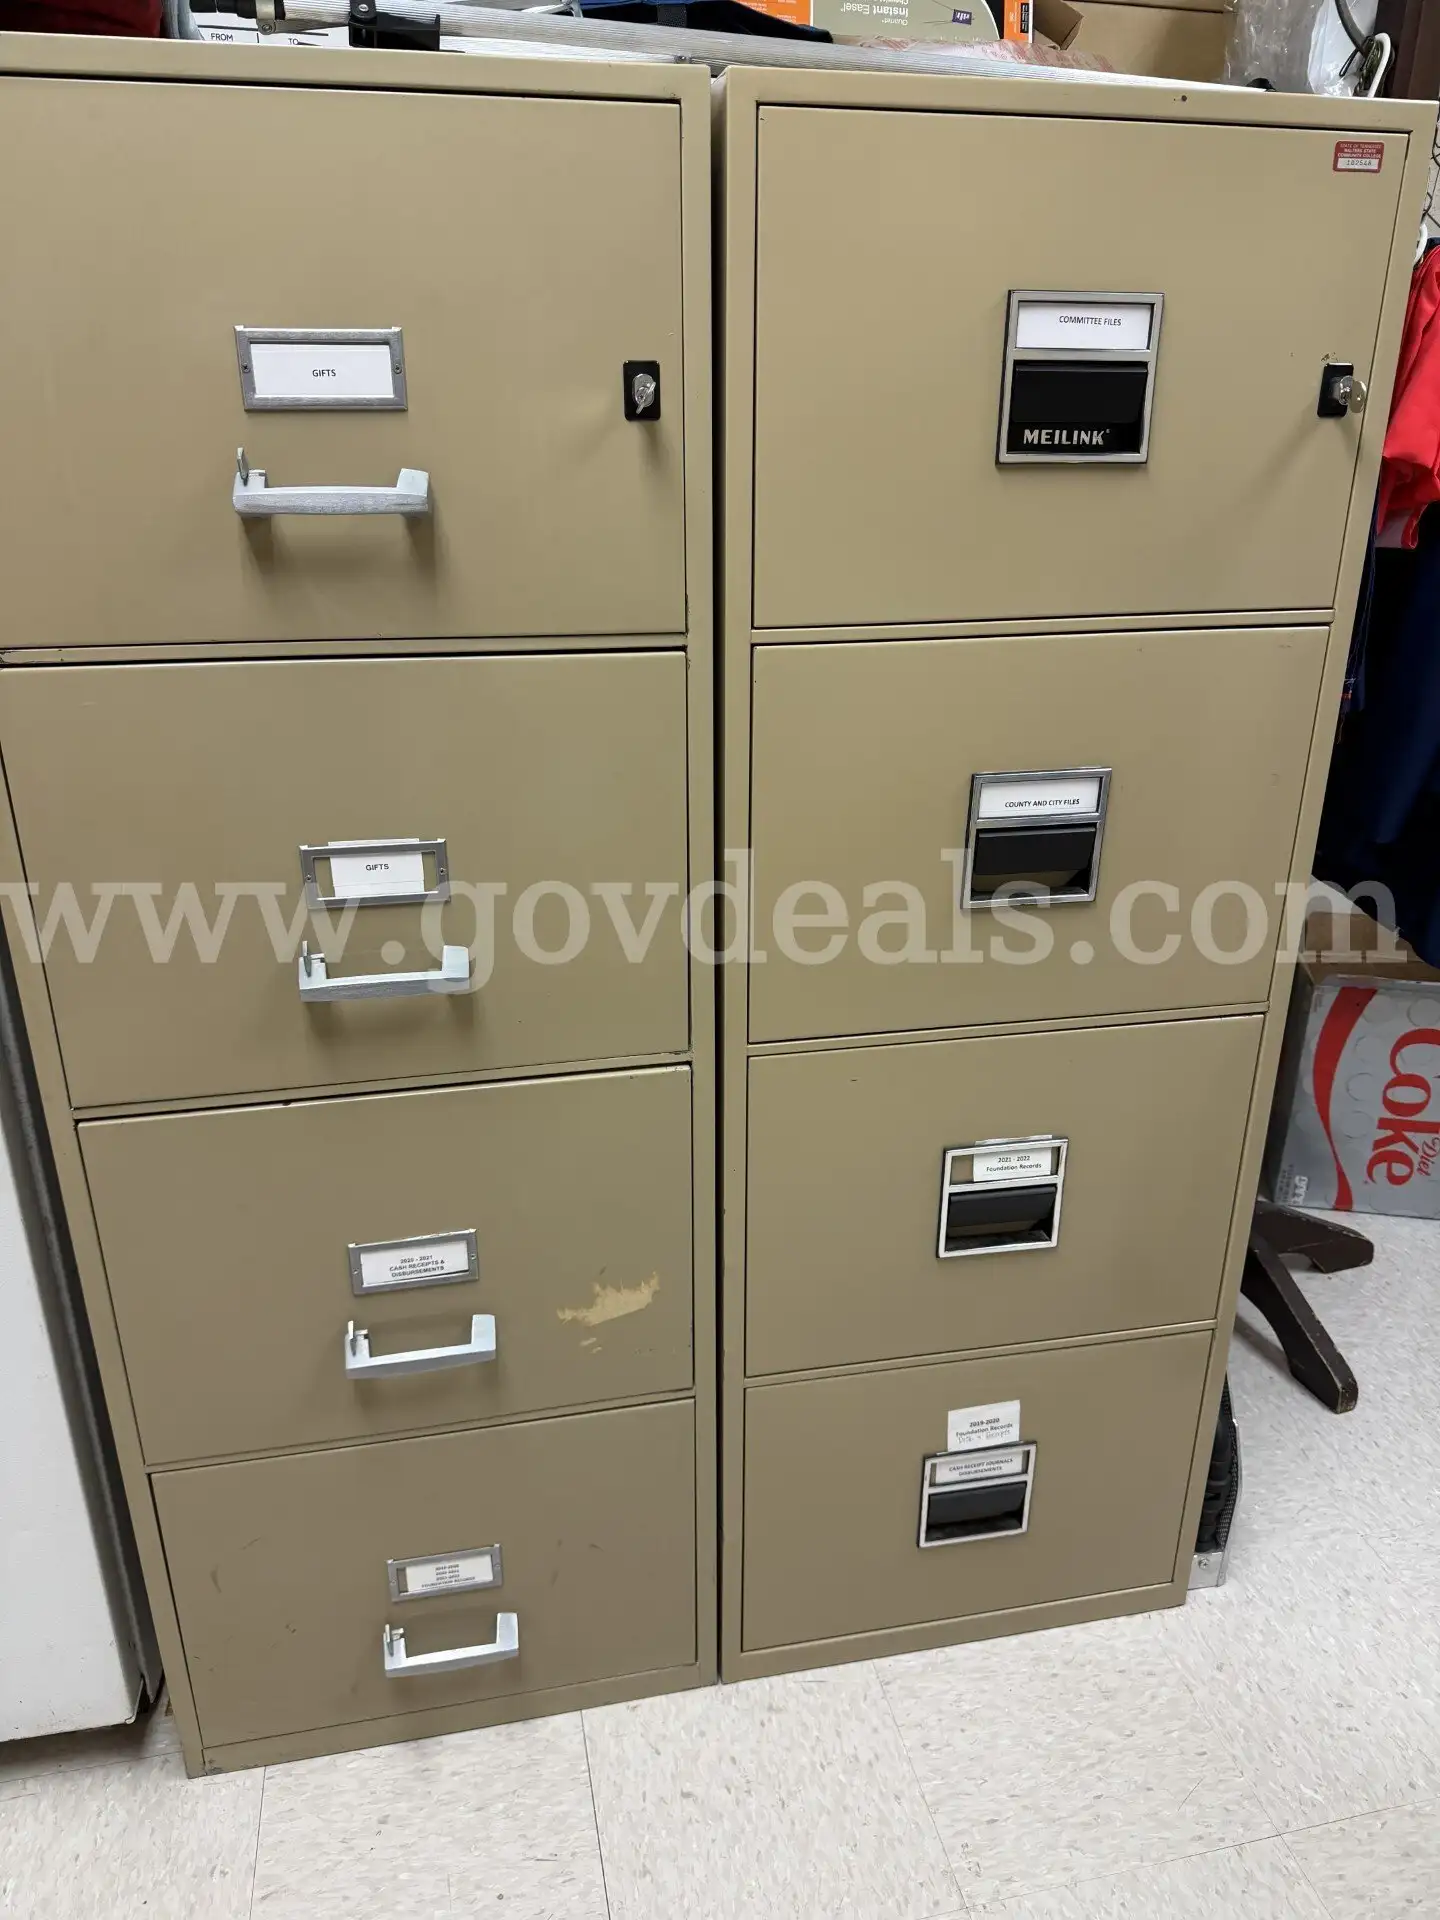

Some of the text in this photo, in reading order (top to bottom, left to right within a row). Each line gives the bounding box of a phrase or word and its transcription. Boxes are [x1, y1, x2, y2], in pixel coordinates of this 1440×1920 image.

[844, 3, 909, 17] Instant Easel
[210, 33, 234, 41] FROM
[1059, 315, 1122, 327] COMMITTEE FILES
[312, 369, 337, 377] GIFTS
[1023, 429, 1105, 445] MEILINK
[1005, 800, 1032, 808] COUNTY
[1032, 799, 1047, 807] AND
[1063, 798, 1080, 806] FILES
[365, 863, 390, 871] GIFTS
[1366, 1028, 1440, 1188] Coke
[1416, 1136, 1440, 1178] Diet
[986, 1163, 1018, 1172] Foundation
[408, 1260, 438, 1270] RECEIPTS
[391, 1265, 445, 1278] DISBURSEMENTS
[955, 1427, 989, 1437] Foundation
[989, 1422, 1013, 1432] Records
